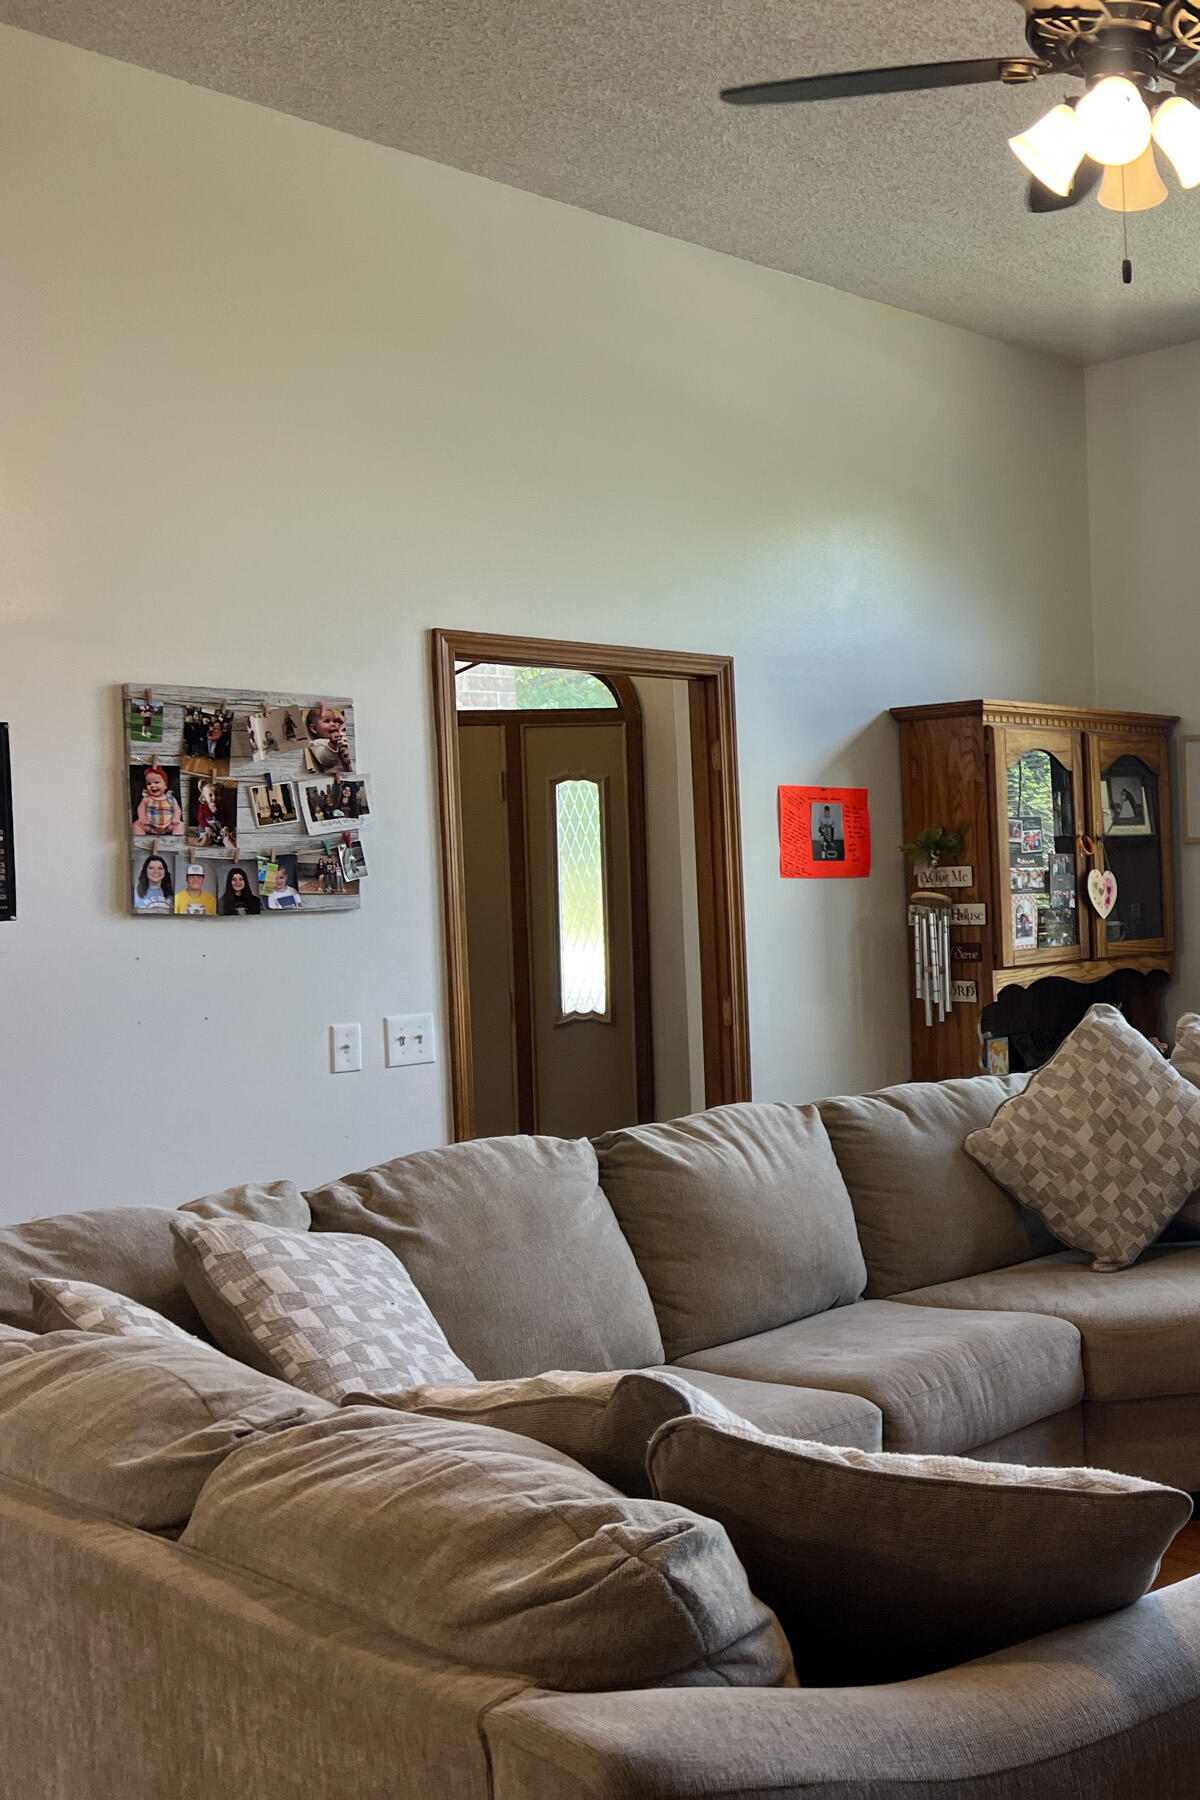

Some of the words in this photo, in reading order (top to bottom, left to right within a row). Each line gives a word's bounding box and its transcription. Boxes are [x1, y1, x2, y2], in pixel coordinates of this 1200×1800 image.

[952, 869, 969, 883] Me
[951, 907, 983, 921] House
[953, 946, 979, 960] Serve
